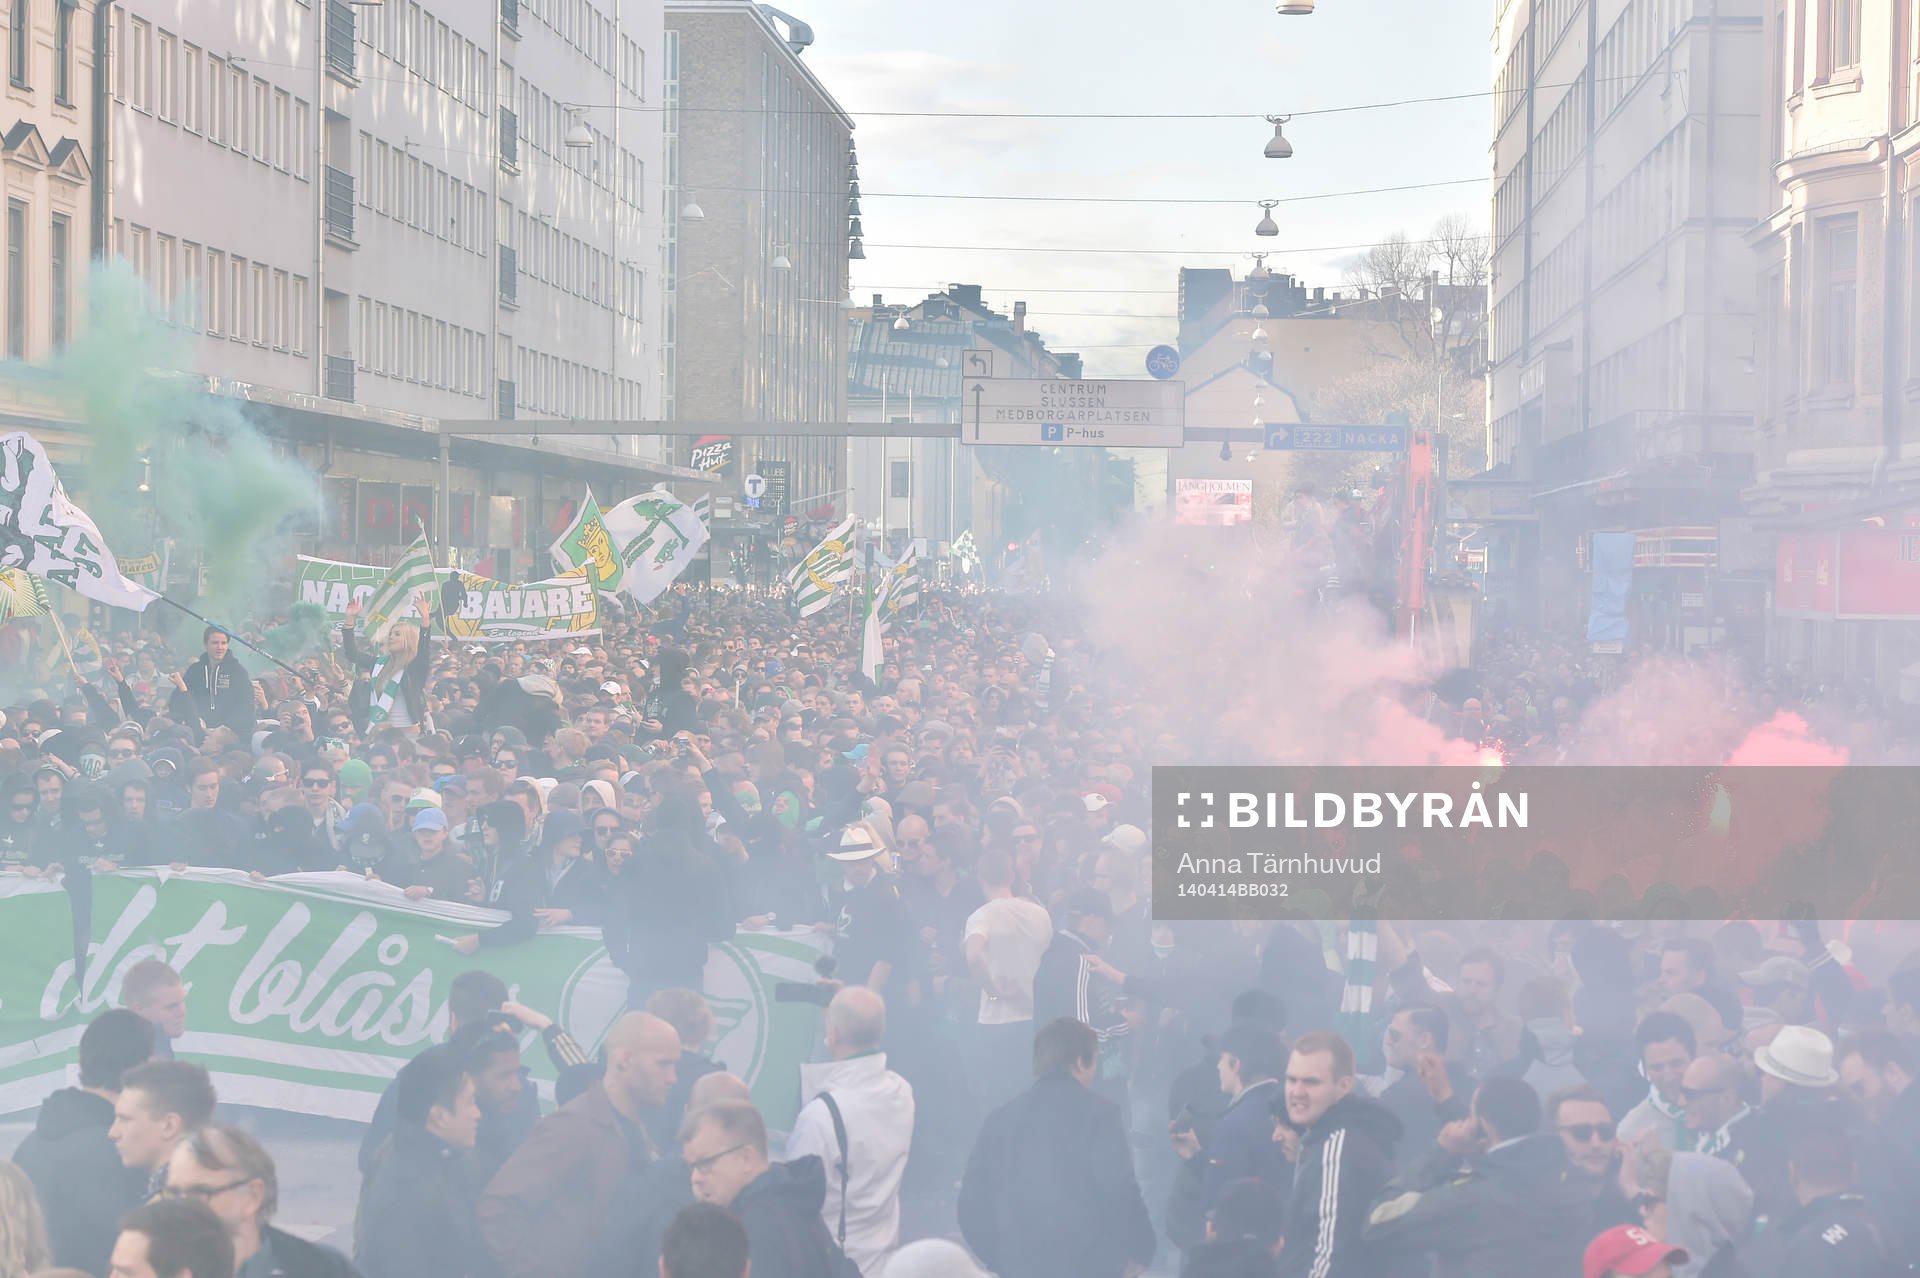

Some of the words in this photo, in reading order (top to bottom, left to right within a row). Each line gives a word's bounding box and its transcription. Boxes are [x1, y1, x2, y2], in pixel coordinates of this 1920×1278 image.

[1040, 383, 1106, 395] CENTRUM
[1040, 396, 1105, 408] SLUSSEN
[995, 409, 1150, 422] MEDBORGARPLATSEN
[1066, 427, 1105, 438] P-hus
[1302, 432, 1333, 443] 222
[1344, 432, 1400, 445] NACKA
[690, 441, 733, 468] Pizza
[699, 453, 729, 472] Hut
[459, 583, 593, 620] BAJARE
